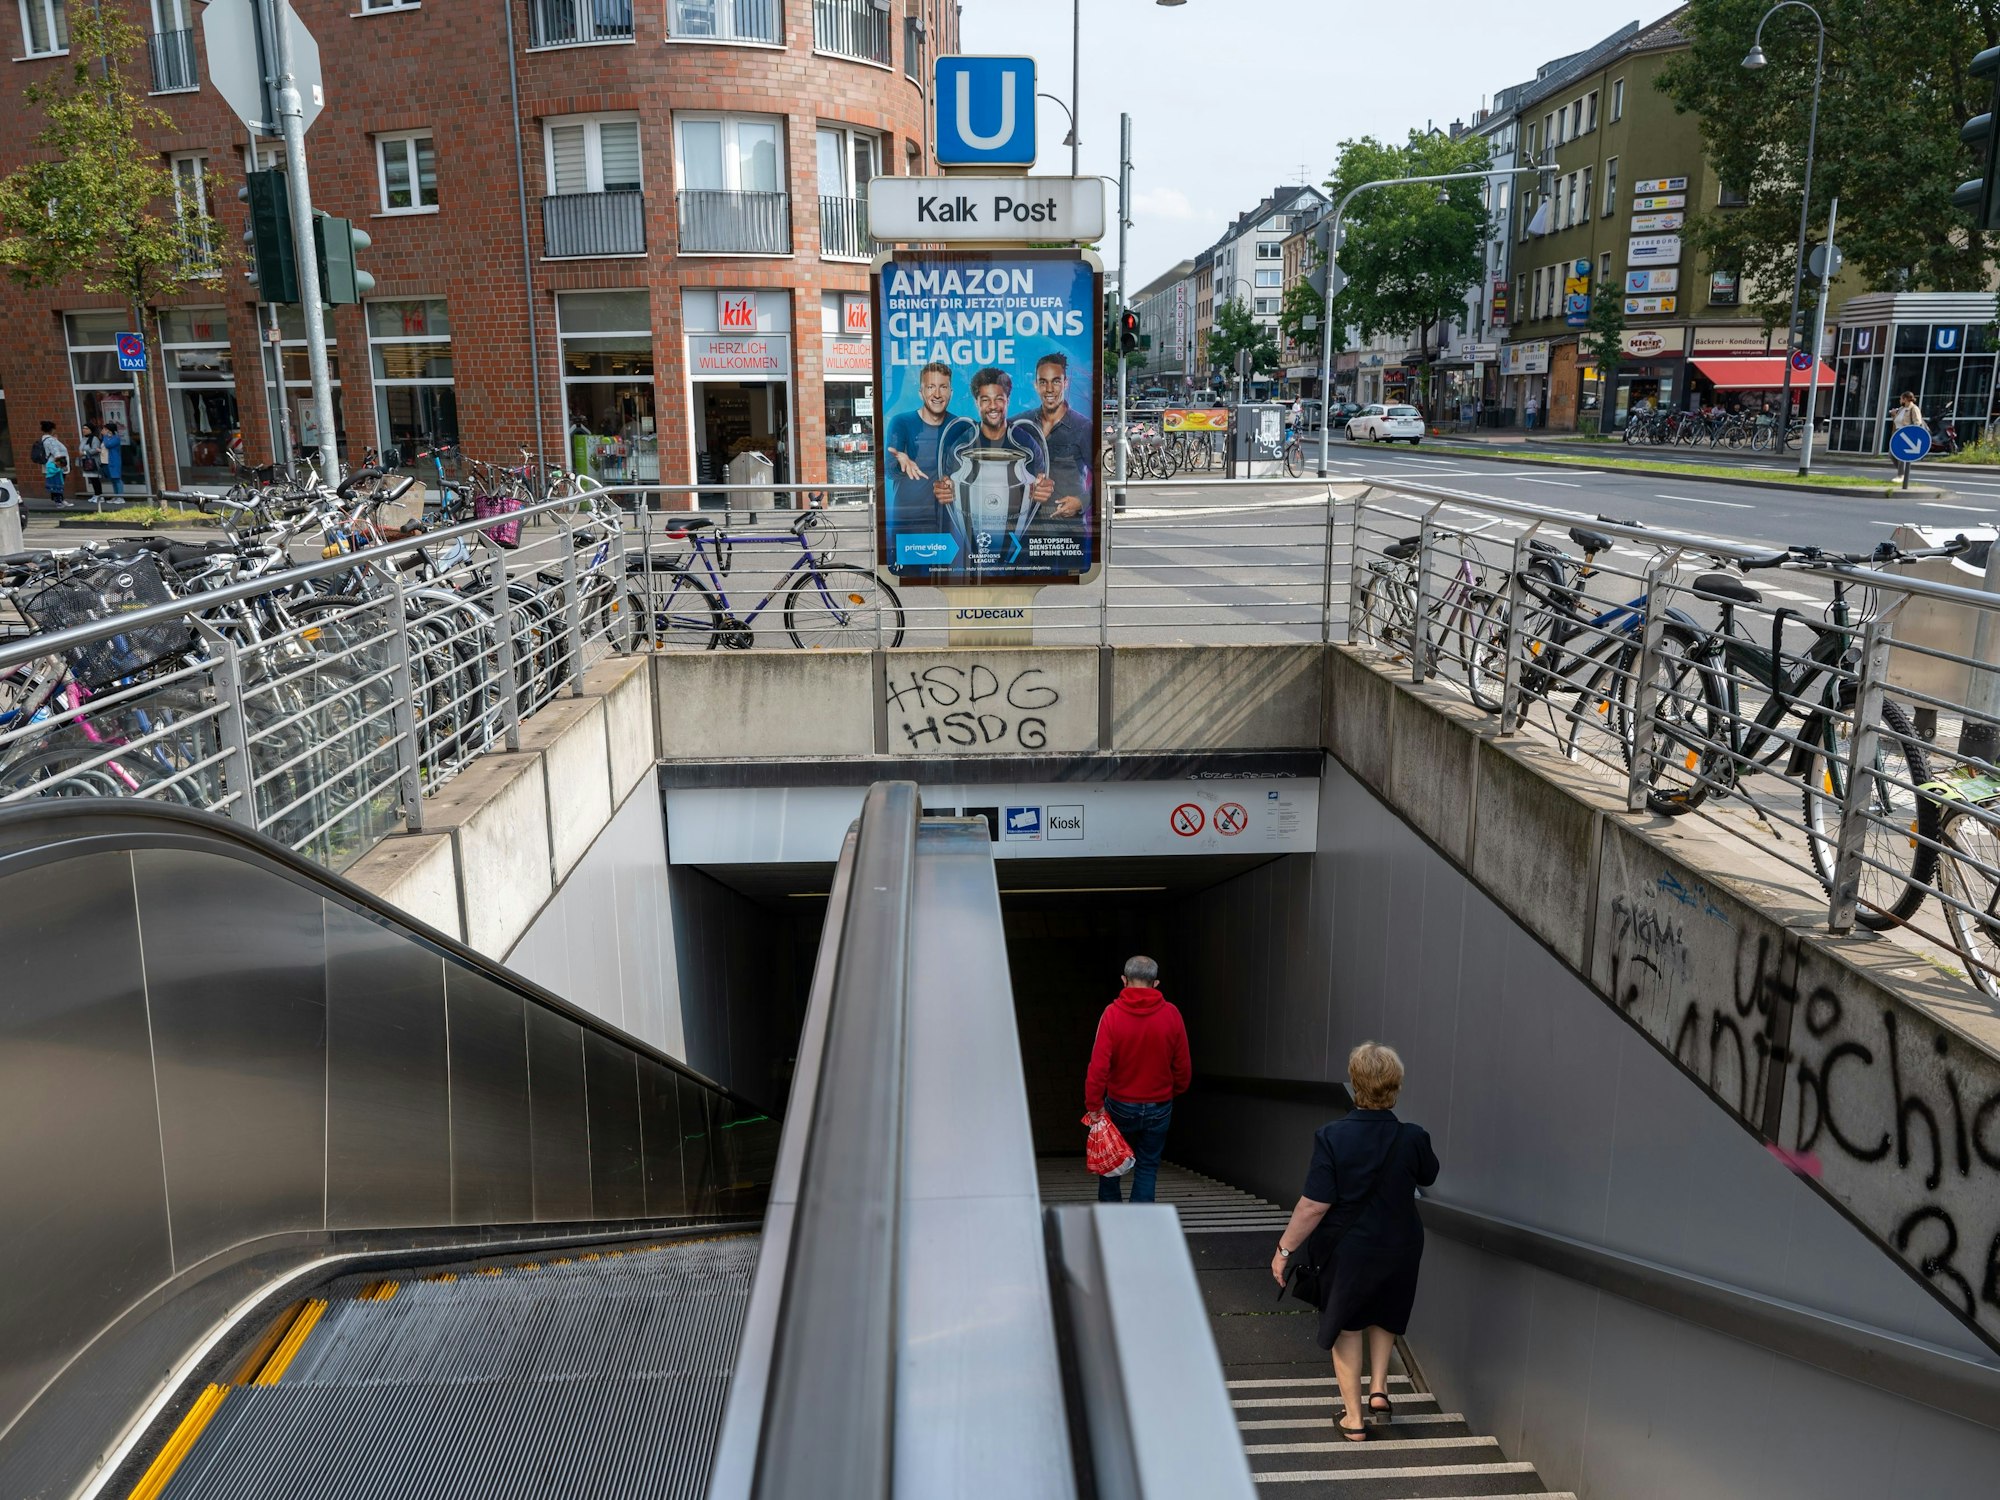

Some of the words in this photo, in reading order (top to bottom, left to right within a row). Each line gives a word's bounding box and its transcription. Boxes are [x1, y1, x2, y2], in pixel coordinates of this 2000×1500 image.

[956, 71, 1016, 150] U
[918, 196, 978, 222] Kalk
[994, 196, 1057, 222] Post
[1631, 238, 1678, 246] REISEBÜRO
[889, 268, 1034, 296] AMAZON
[889, 298, 937, 310] BRINGT
[940, 298, 962, 309] DIR
[965, 298, 1003, 308] JETZT
[1006, 297, 1028, 308] DIE
[1031, 296, 1063, 308] UEFA
[723, 299, 753, 326] kik
[847, 302, 868, 328] kik
[888, 310, 1084, 338] CHAMPIONS
[1729, 337, 1765, 345] Konditorei
[1858, 332, 1870, 350] U
[1938, 330, 1955, 348] U
[709, 342, 767, 354] HERZLICH
[832, 344, 871, 354] HERZLICH
[890, 340, 1015, 366] LEAGUE
[122, 359, 144, 367] TAXI
[699, 357, 778, 369] WILLKOMMEN
[826, 358, 872, 369] WILLKOMME
[905, 544, 927, 552] prime
[927, 543, 947, 551] video
[956, 608, 1024, 620] JCDecaux
[886, 664, 1059, 712] HSDG
[902, 710, 1047, 750] HSDG
[1050, 816, 1081, 829] Kiosk
